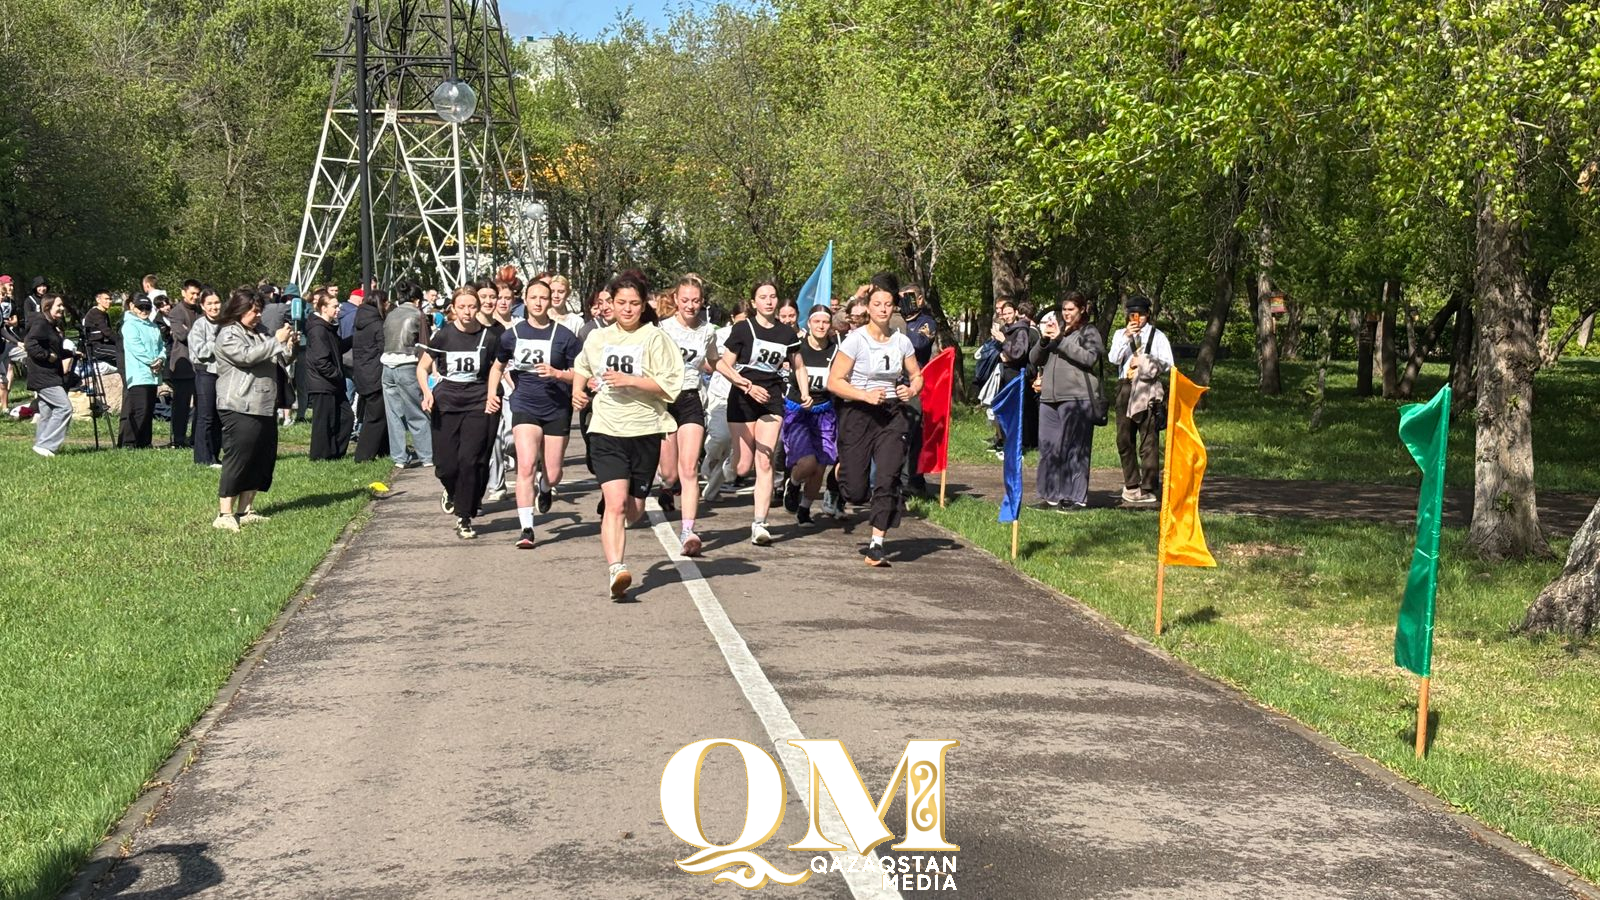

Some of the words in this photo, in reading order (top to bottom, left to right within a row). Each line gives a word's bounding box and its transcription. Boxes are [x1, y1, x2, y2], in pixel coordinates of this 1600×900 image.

[454, 357, 475, 372] 18
[520, 348, 544, 365] 23
[606, 354, 634, 374] 98
[758, 348, 781, 365] 38
[882, 355, 890, 370] 1
